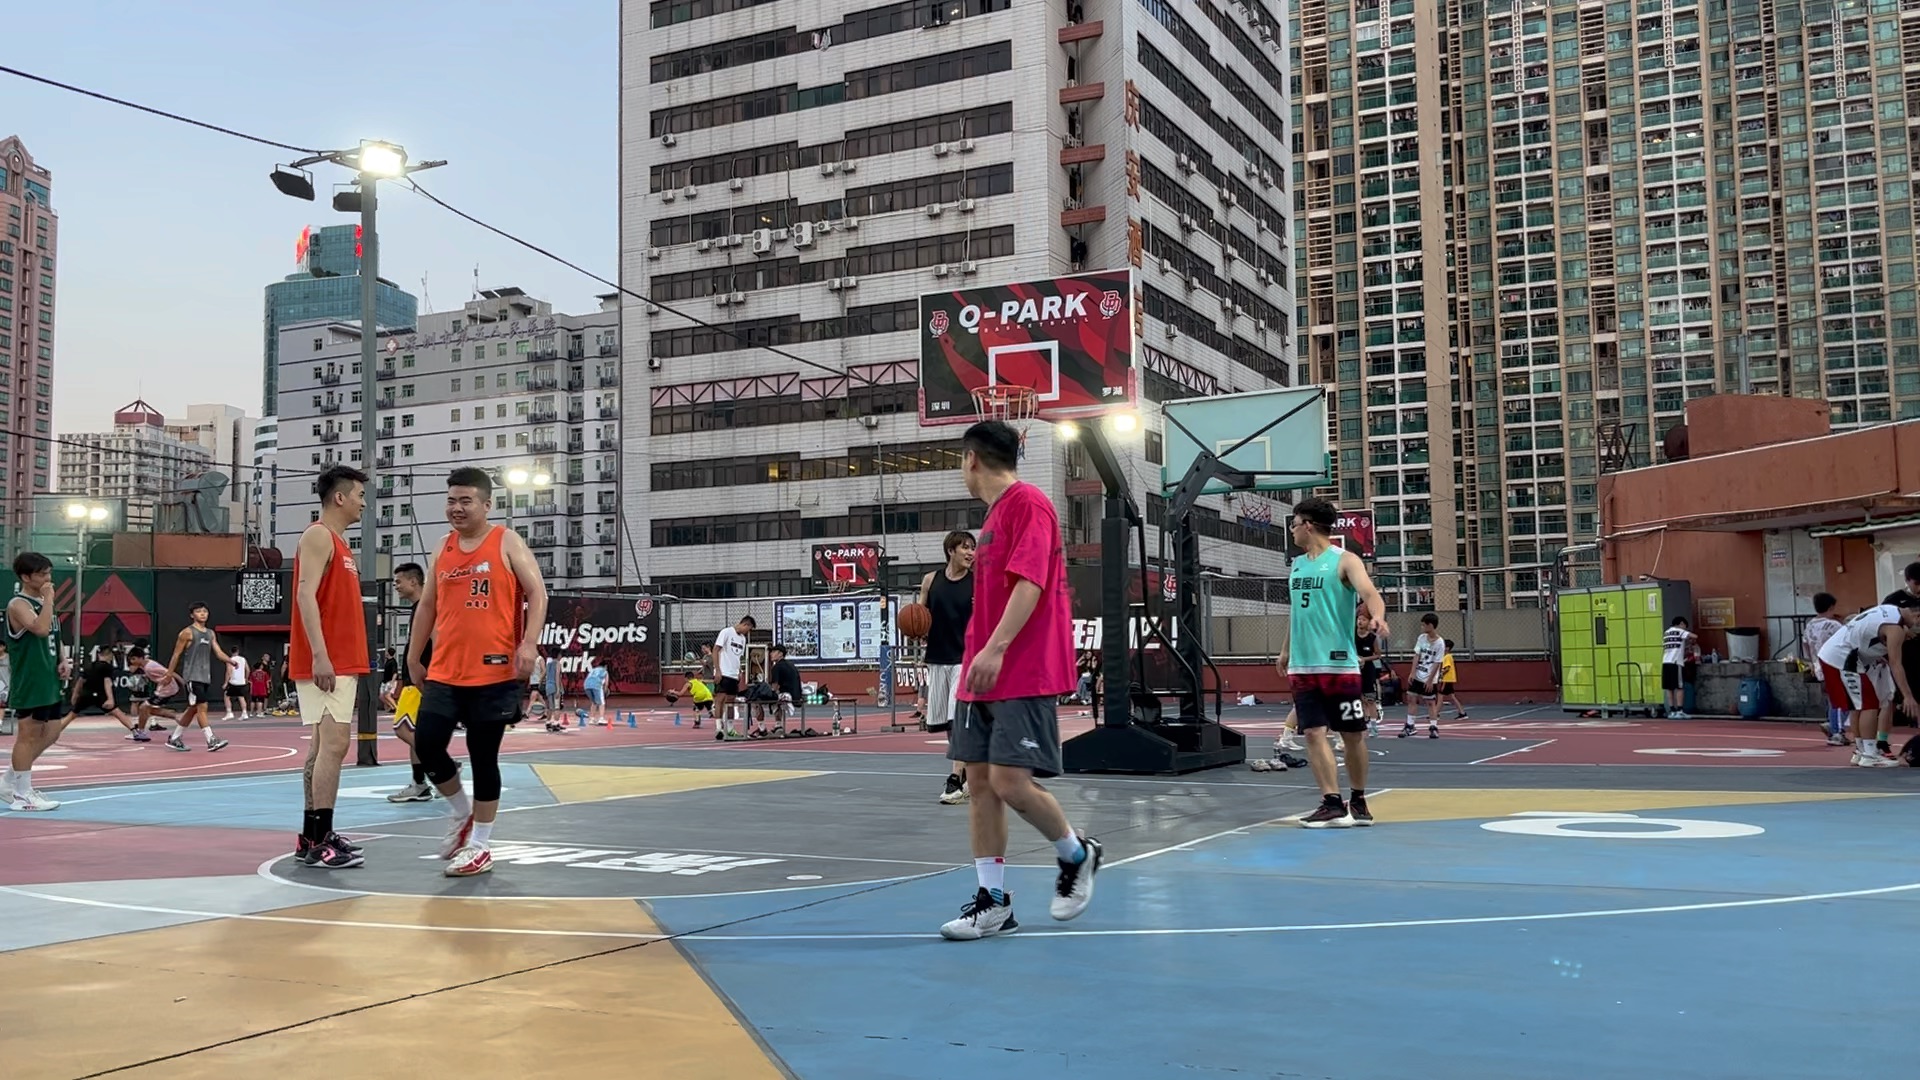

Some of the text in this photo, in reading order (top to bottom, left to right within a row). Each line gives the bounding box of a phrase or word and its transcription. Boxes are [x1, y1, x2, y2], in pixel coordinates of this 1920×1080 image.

[958, 291, 1089, 334] Q-PARK
[824, 548, 865, 560] Q-PARK
[470, 578, 490, 597] 34
[1301, 592, 1310, 608] 5
[577, 623, 648, 649] Sports
[1339, 699, 1364, 721] 29
